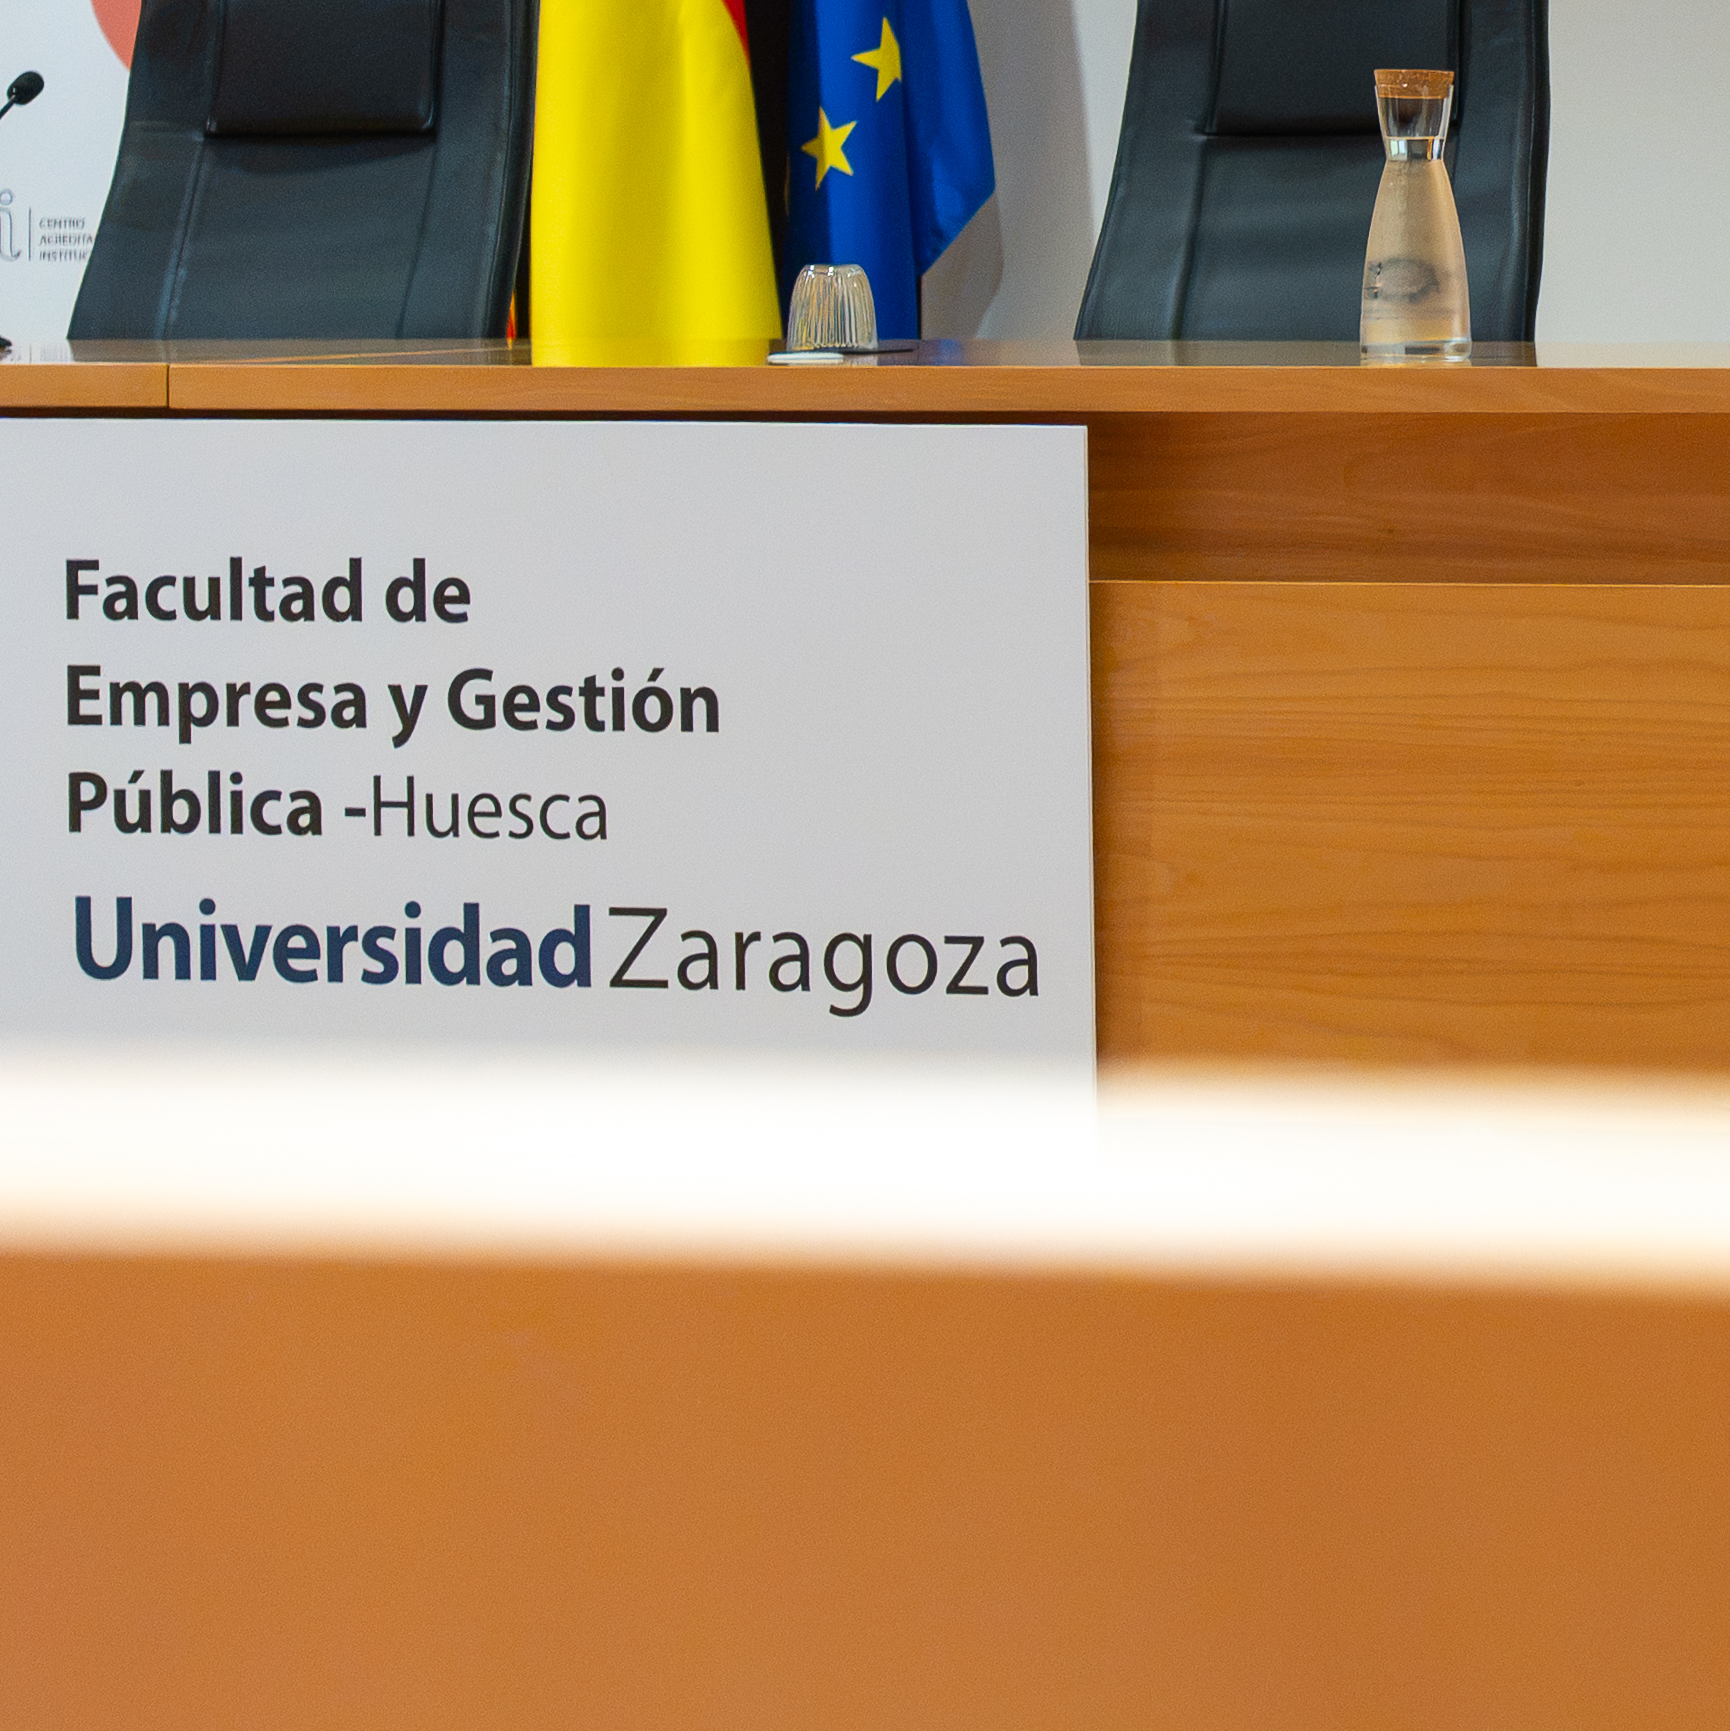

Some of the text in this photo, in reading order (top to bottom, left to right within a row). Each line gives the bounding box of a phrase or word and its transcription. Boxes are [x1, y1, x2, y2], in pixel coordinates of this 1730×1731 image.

[65, 556, 472, 626] Facultad de
[66, 664, 722, 749] Empresa y Gestión
[67, 768, 325, 838] Pública
[606, 905, 1041, 1019] Zaragoza
